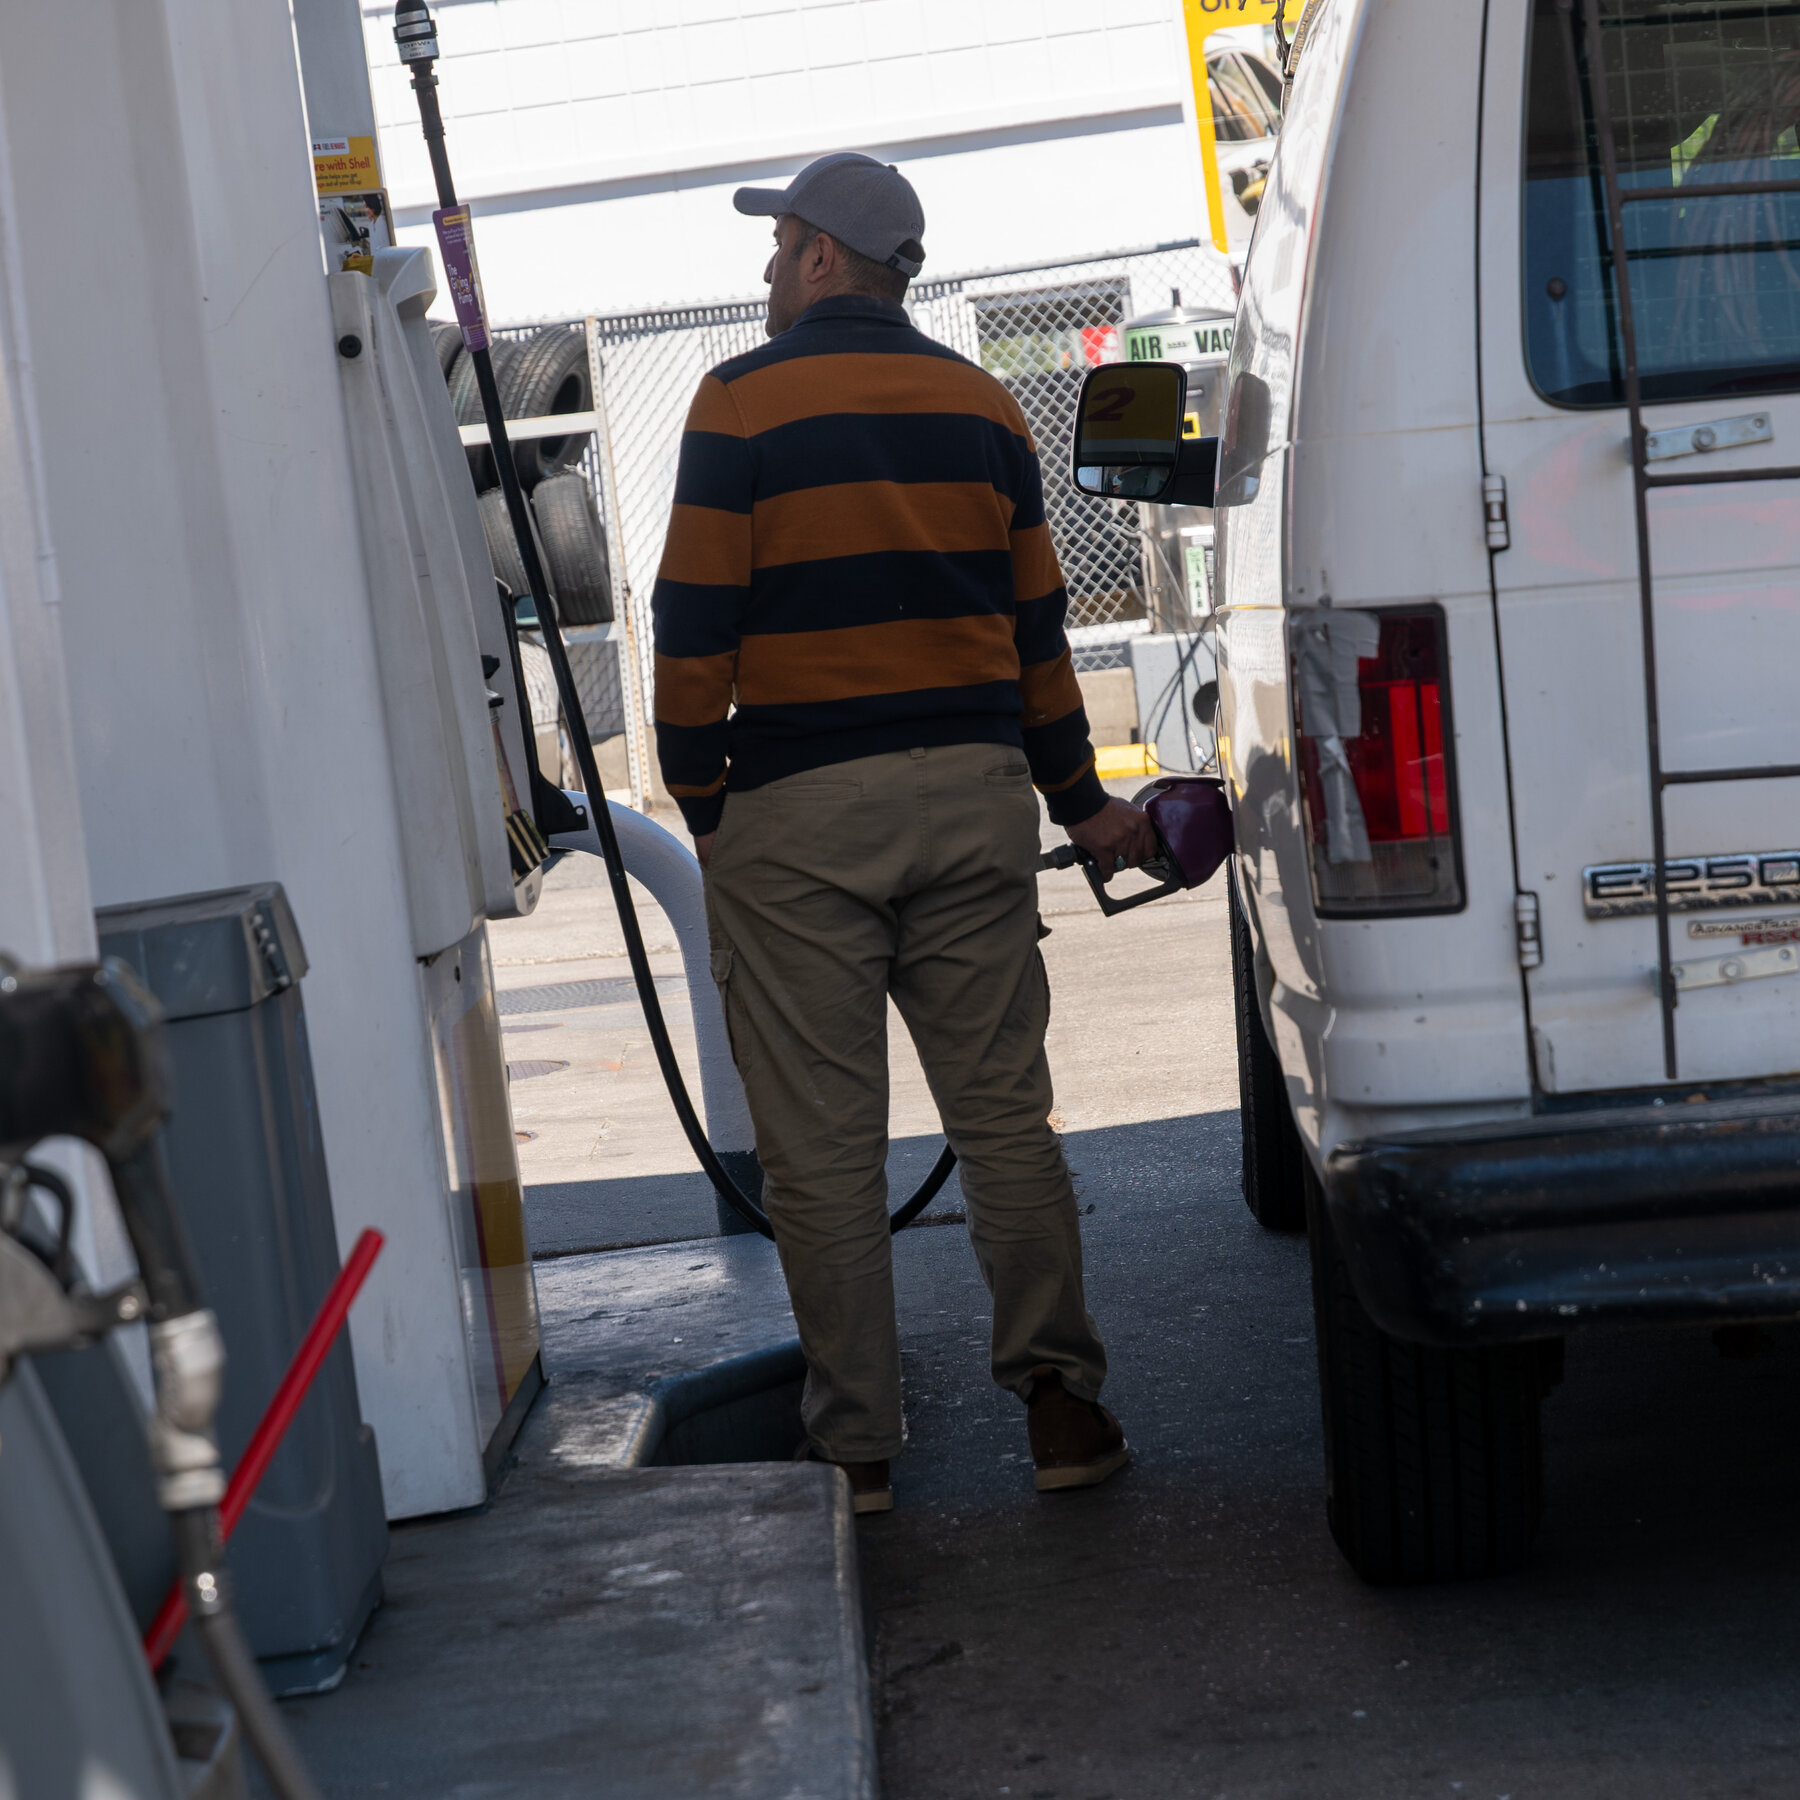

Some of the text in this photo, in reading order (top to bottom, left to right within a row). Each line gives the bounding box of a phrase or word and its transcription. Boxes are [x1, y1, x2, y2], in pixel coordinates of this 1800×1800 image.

[326, 158, 347, 170] with
[348, 156, 370, 169] Shell
[446, 263, 458, 276] The
[450, 275, 469, 290] Giving
[457, 291, 473, 306] Pump
[1130, 334, 1163, 361] AIR
